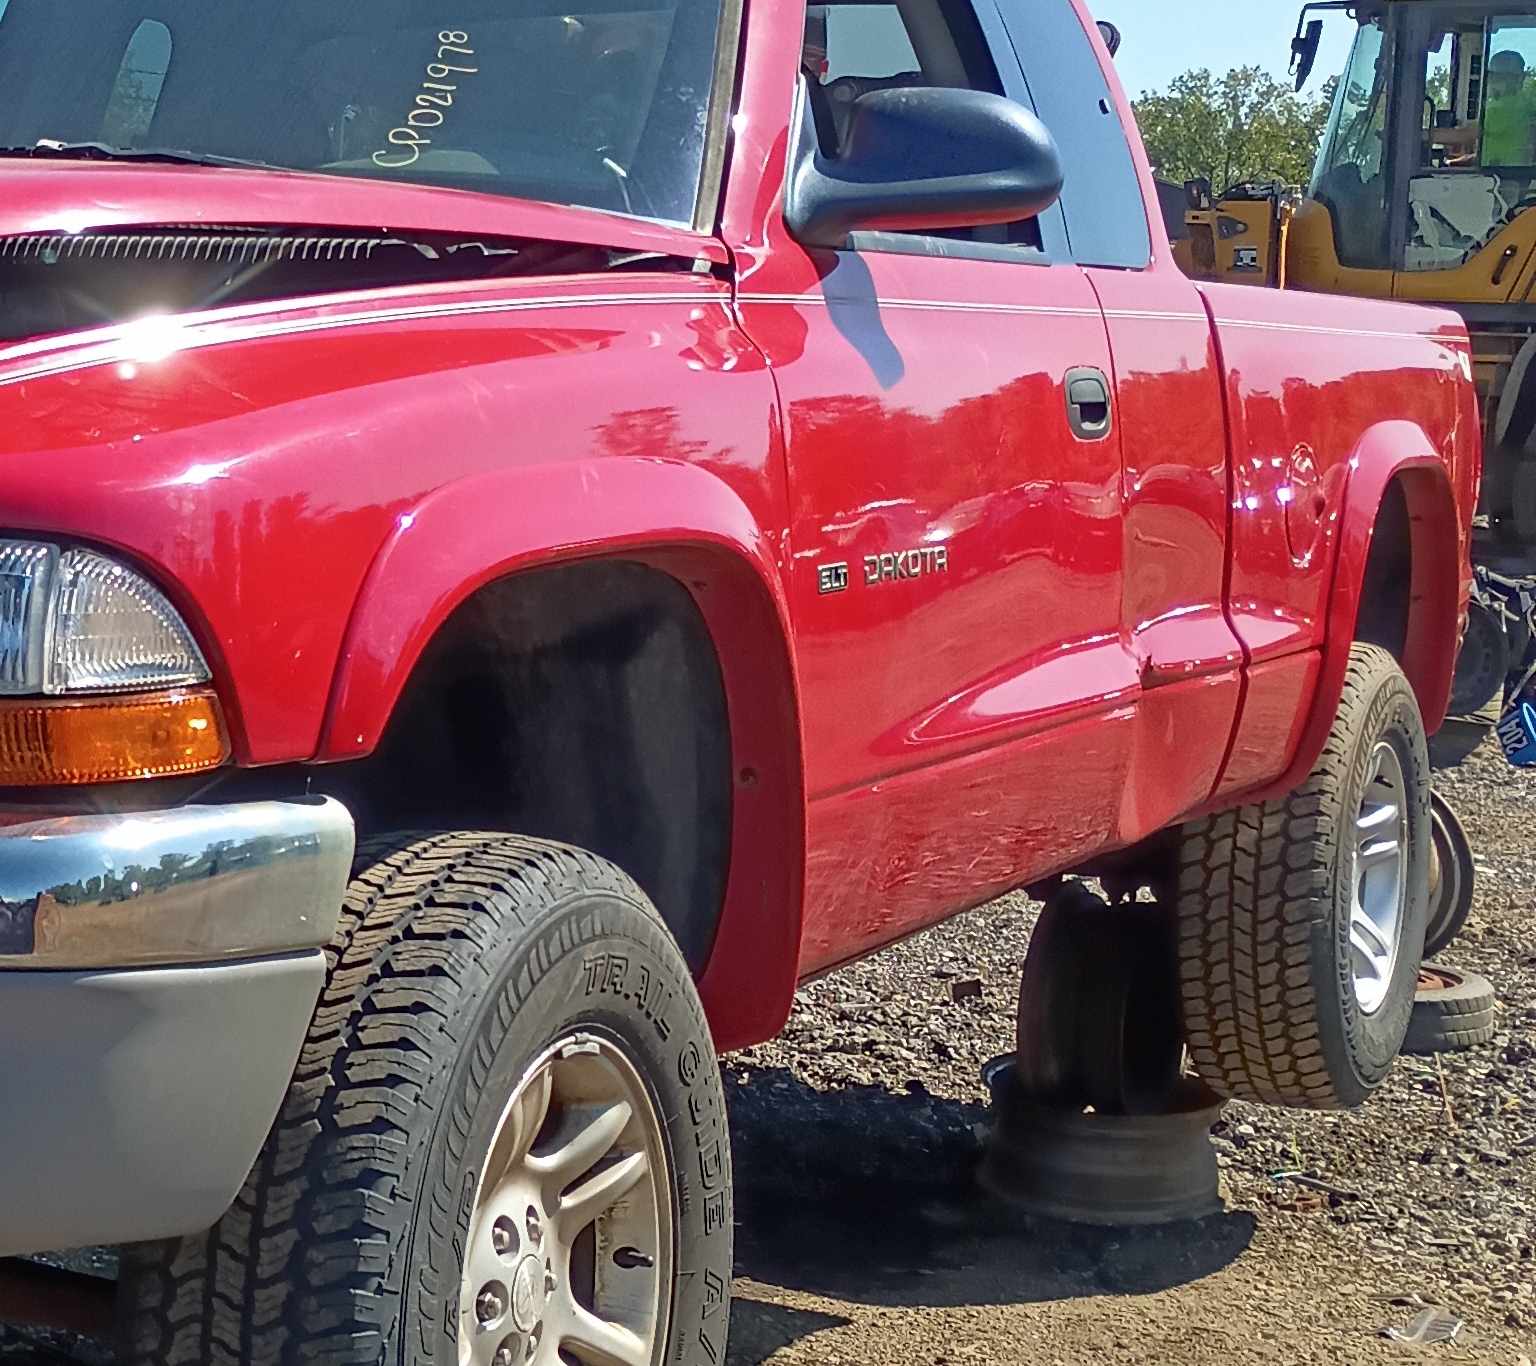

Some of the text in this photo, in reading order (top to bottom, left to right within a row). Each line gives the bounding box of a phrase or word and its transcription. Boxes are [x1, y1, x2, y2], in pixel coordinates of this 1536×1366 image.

[819, 544, 949, 591] SLT DAKOTA
[582, 951, 672, 1043] TRAIL
[677, 1039, 726, 1235] GUIDE
